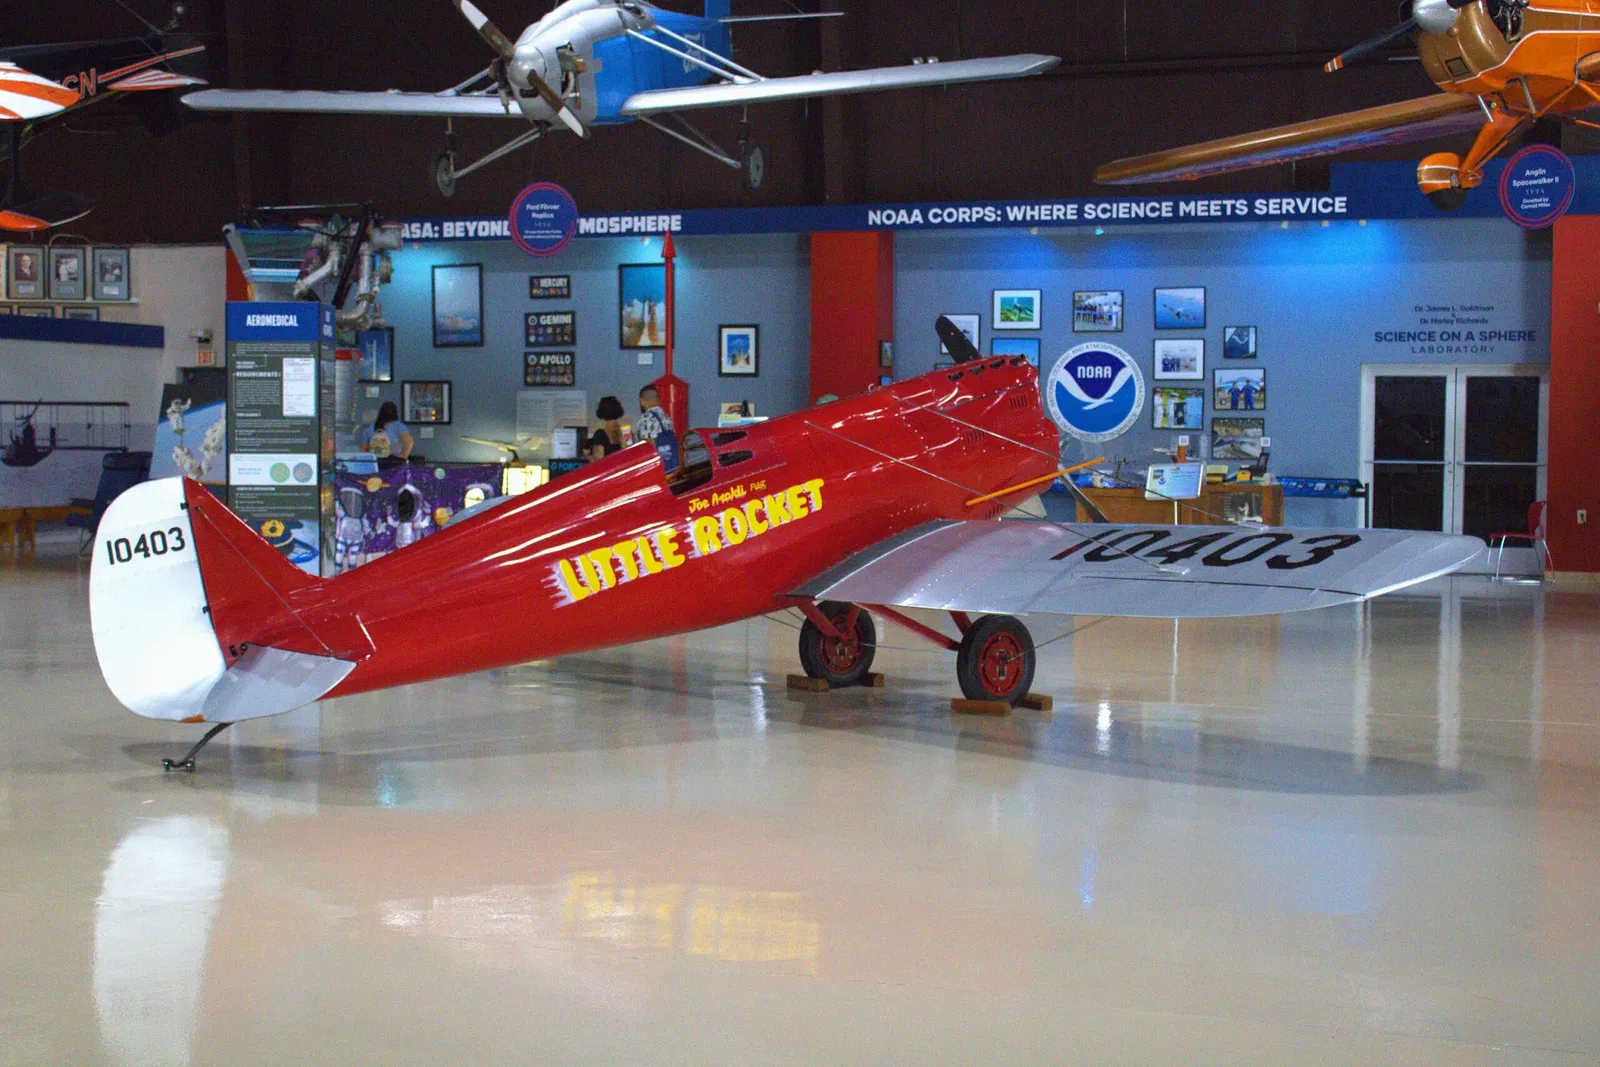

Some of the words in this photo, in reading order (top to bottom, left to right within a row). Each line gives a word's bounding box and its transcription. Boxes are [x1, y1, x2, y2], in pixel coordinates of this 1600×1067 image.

[1525, 168, 1546, 177] Anglin
[1512, 177, 1554, 188] Spacewalker
[526, 203, 539, 211] Ford
[868, 209, 923, 226] NOAA
[928, 206, 1001, 224] CORPS:
[1006, 204, 1078, 222] WHERE
[1083, 201, 1174, 219] SCIENCE
[1179, 199, 1248, 217] MEETS
[1254, 197, 1348, 215] SERVICE
[401, 222, 439, 239] ASA:
[577, 215, 682, 234] MOSPHERE
[539, 278, 568, 288] MERCURY
[246, 314, 299, 327] AEROMEDICAL
[539, 314, 572, 325] GEMINI
[1456, 317, 1488, 325] Richards
[1374, 331, 1437, 343] SCIENCE
[1440, 331, 1461, 342] ON
[1465, 331, 1475, 342] A
[1479, 330, 1536, 342] SPHERE
[1411, 345, 1496, 354] LABORATORY
[539, 354, 571, 365] APOLLO
[1077, 366, 1112, 379] NOAA
[689, 498, 710, 514] Joe
[106, 526, 186, 565] 10403
[558, 528, 686, 601] LITTLE
[693, 478, 825, 556] ROCKET
[1049, 529, 1362, 570] 10403
